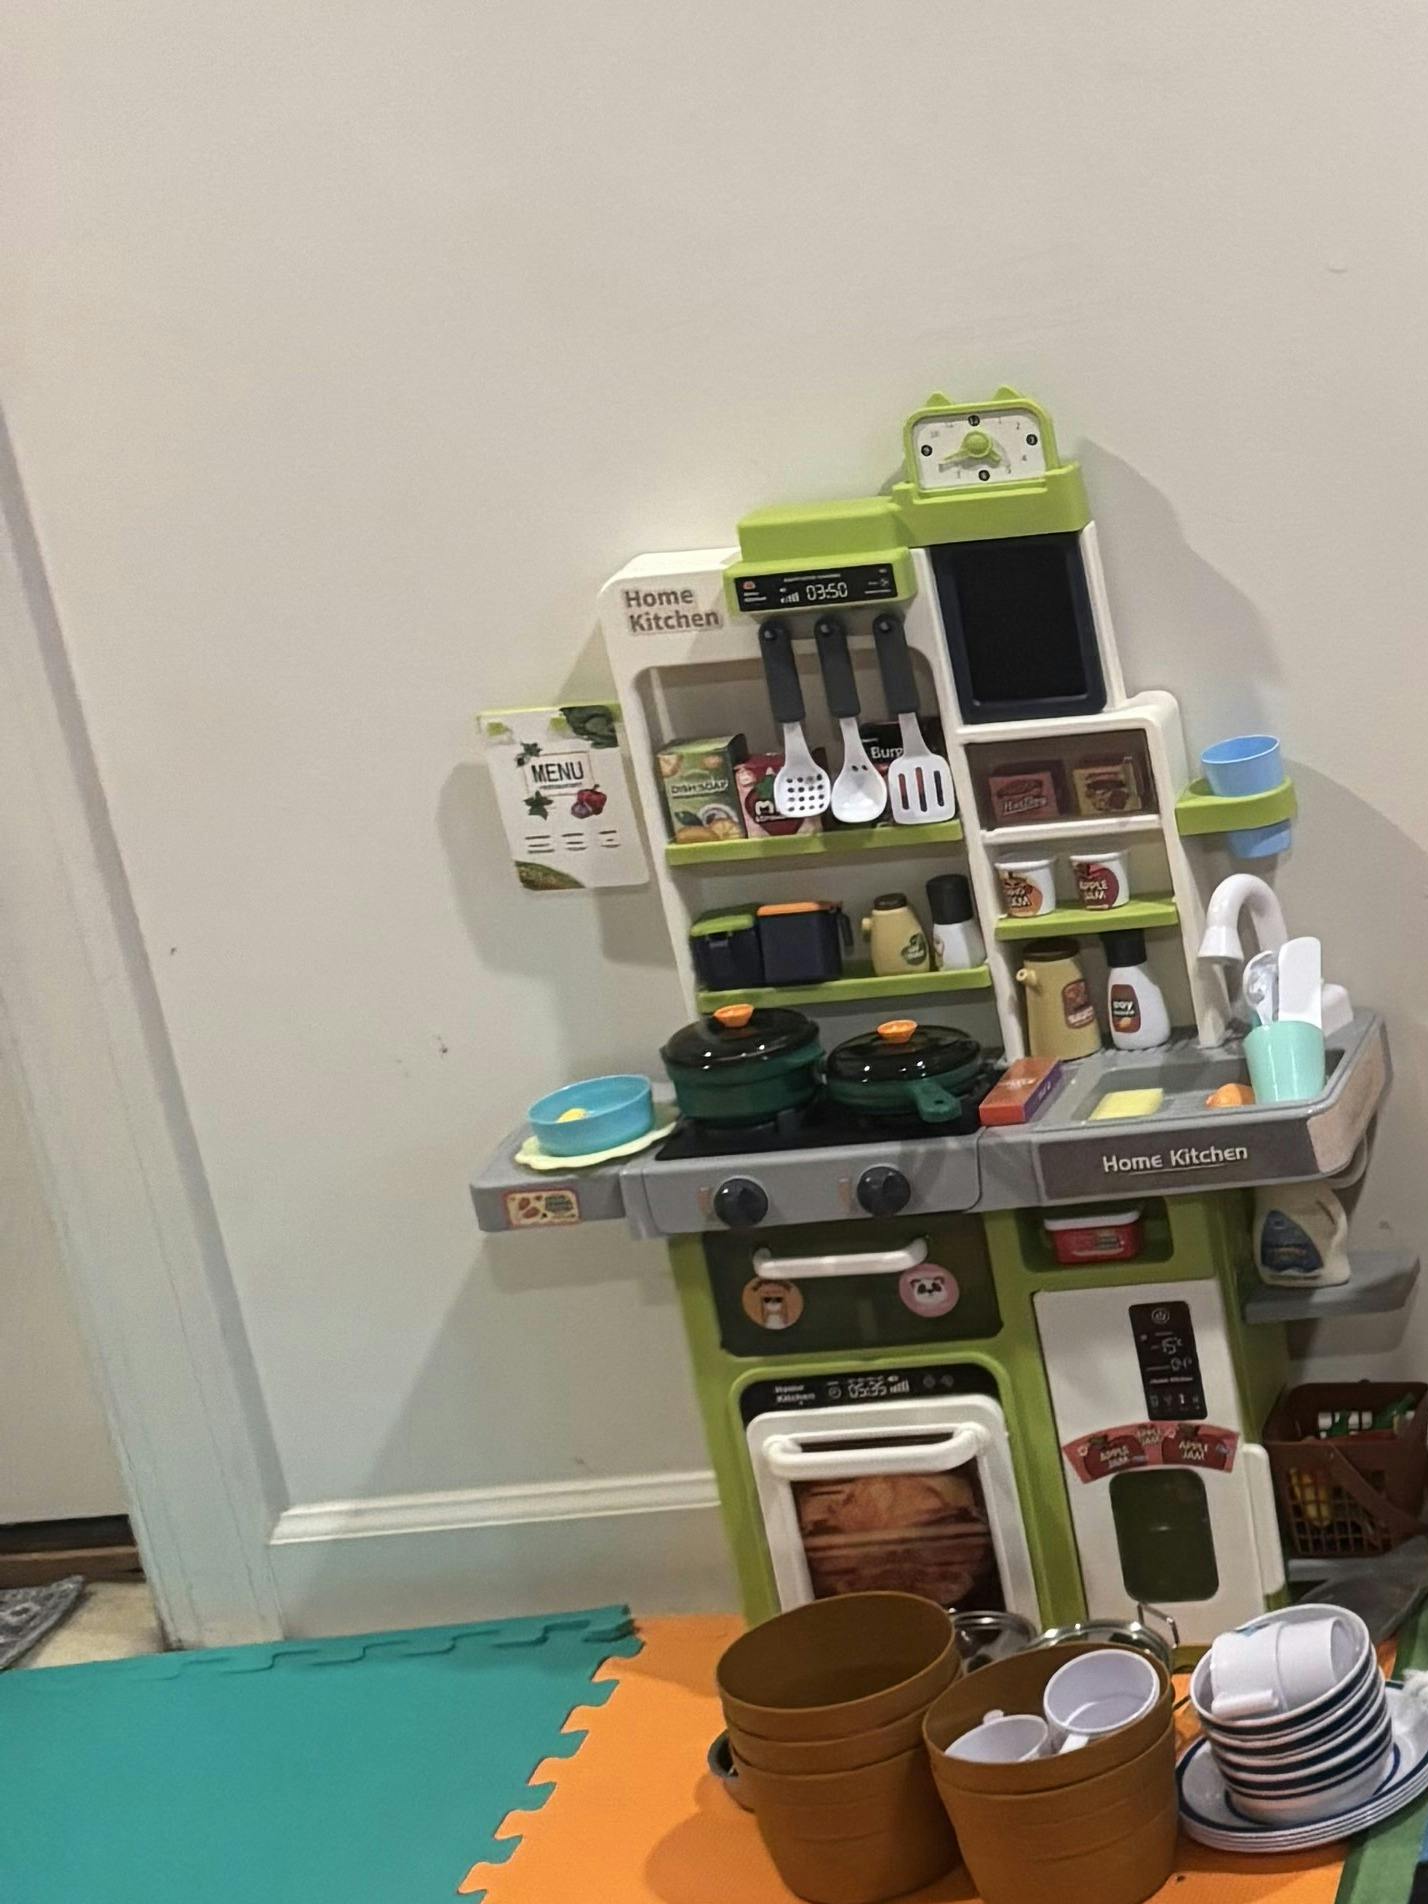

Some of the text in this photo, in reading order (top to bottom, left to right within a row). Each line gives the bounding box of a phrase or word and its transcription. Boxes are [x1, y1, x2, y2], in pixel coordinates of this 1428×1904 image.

[624, 587, 694, 609] Home
[805, 581, 848, 602] 03:50
[628, 608, 720, 633] Kitchen
[530, 758, 585, 784] MENU
[1102, 1145, 1248, 1173] Home Kitchen
